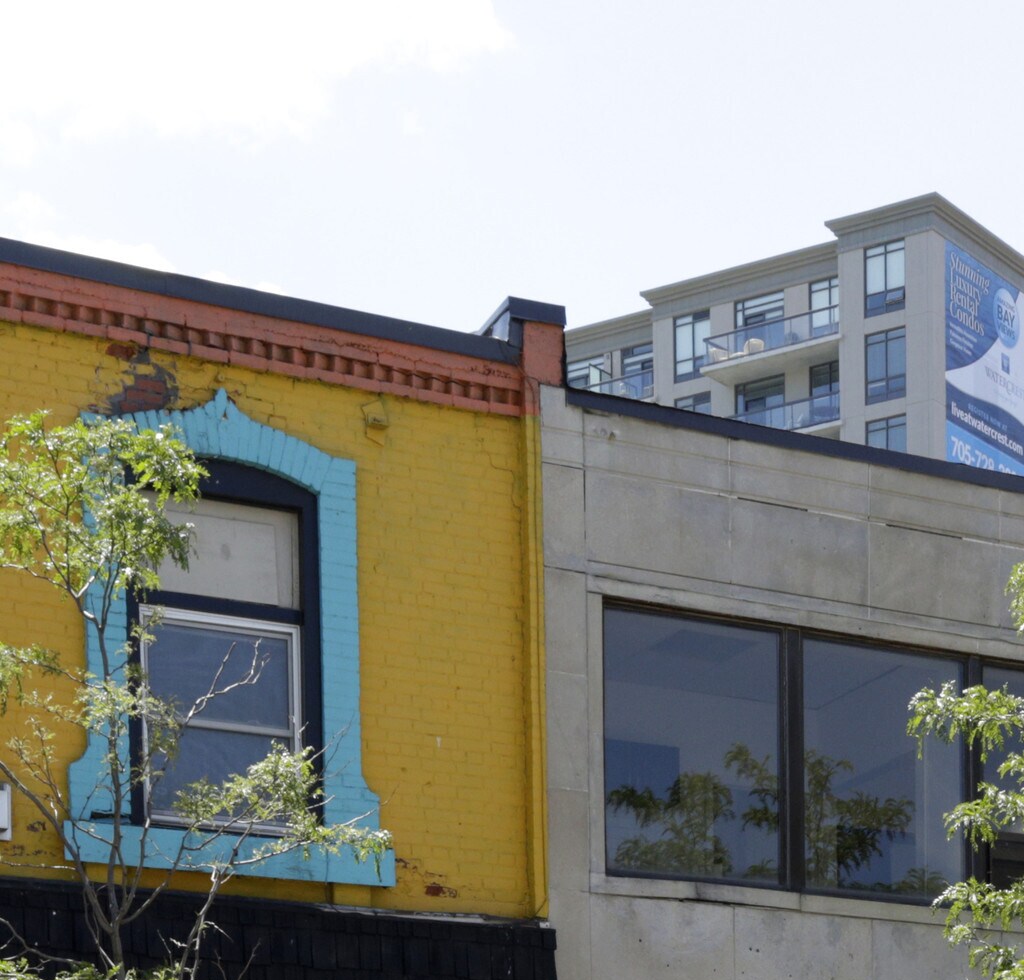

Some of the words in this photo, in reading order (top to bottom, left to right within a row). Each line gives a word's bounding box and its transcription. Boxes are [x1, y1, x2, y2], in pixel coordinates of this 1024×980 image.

[950, 252, 990, 295] Stunning
[950, 267, 981, 302] Luxury
[950, 284, 979, 316] Rental
[997, 304, 1015, 328] BAY
[949, 301, 984, 336] Condos
[951, 401, 1024, 456] liveatwatercrest.com
